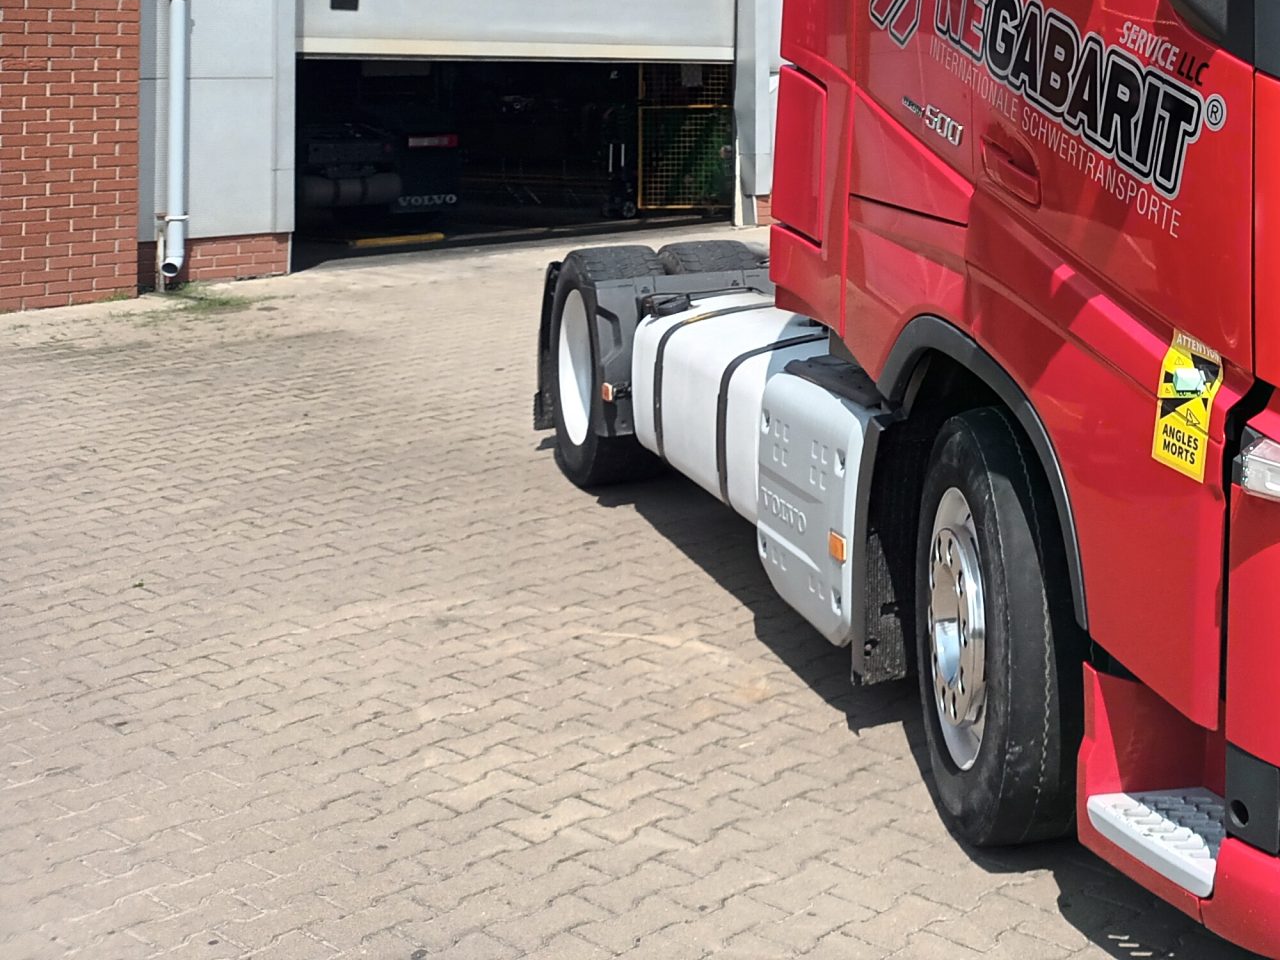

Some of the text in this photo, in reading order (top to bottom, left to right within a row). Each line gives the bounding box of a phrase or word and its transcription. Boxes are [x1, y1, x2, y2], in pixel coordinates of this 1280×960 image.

[1119, 21, 1210, 87] SERVICE LLC
[925, 104, 963, 146] 500
[929, 35, 1182, 238] INTERNATIONALE SCHWERTRANSPORTE
[398, 194, 457, 207] VOLVO
[1162, 424, 1199, 451] ANGLES
[1162, 440, 1196, 465] MORTS
[761, 486, 807, 533] VOLVO
